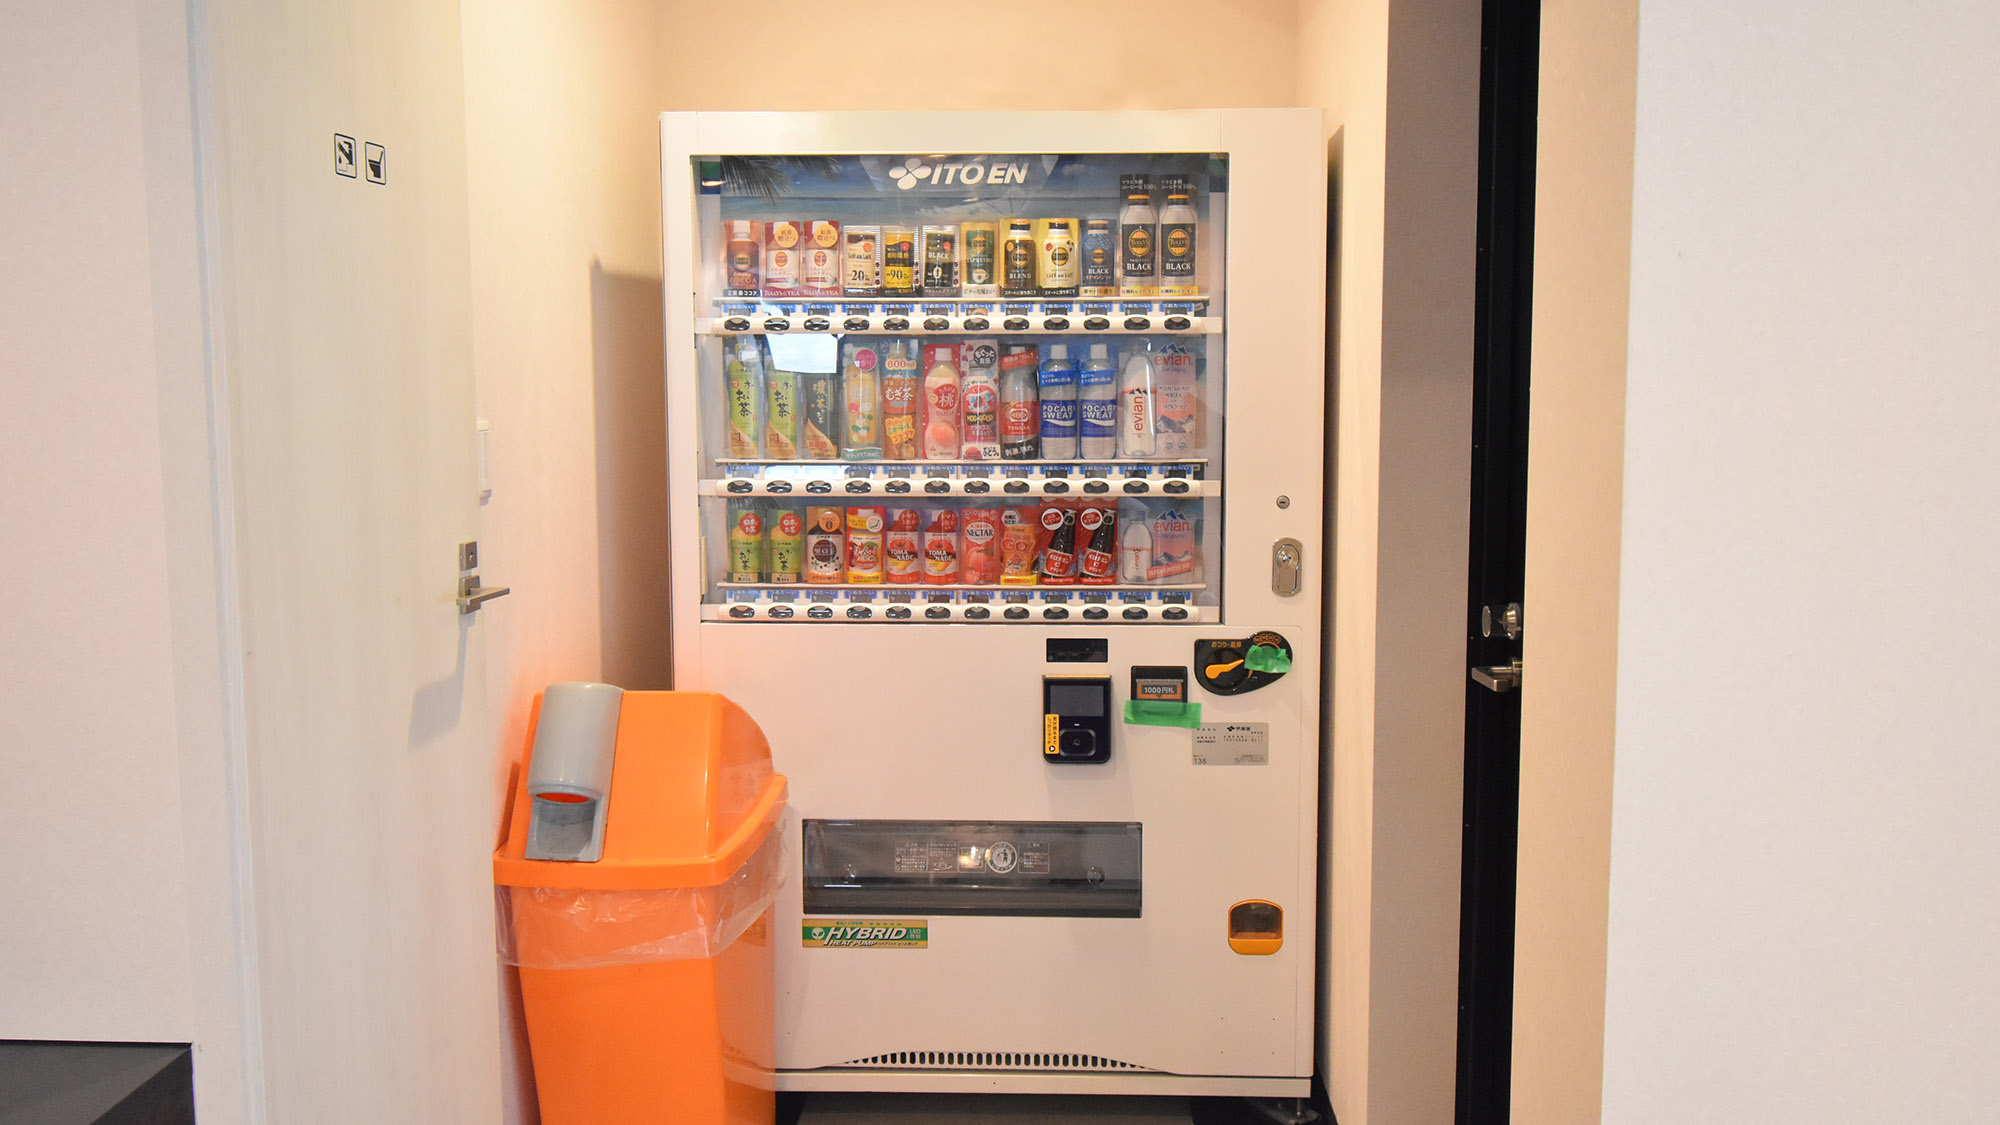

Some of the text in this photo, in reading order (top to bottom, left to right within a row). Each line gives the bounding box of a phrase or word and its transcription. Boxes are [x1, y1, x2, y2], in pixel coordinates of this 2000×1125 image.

[930, 163, 1029, 184] ITO EN
[1154, 353, 1192, 366] evian
[885, 387, 914, 401] むぎ茶
[939, 393, 953, 407] 桃
[1132, 396, 1144, 431] evian
[1154, 521, 1190, 532] evian
[824, 927, 907, 946] HYBRID
